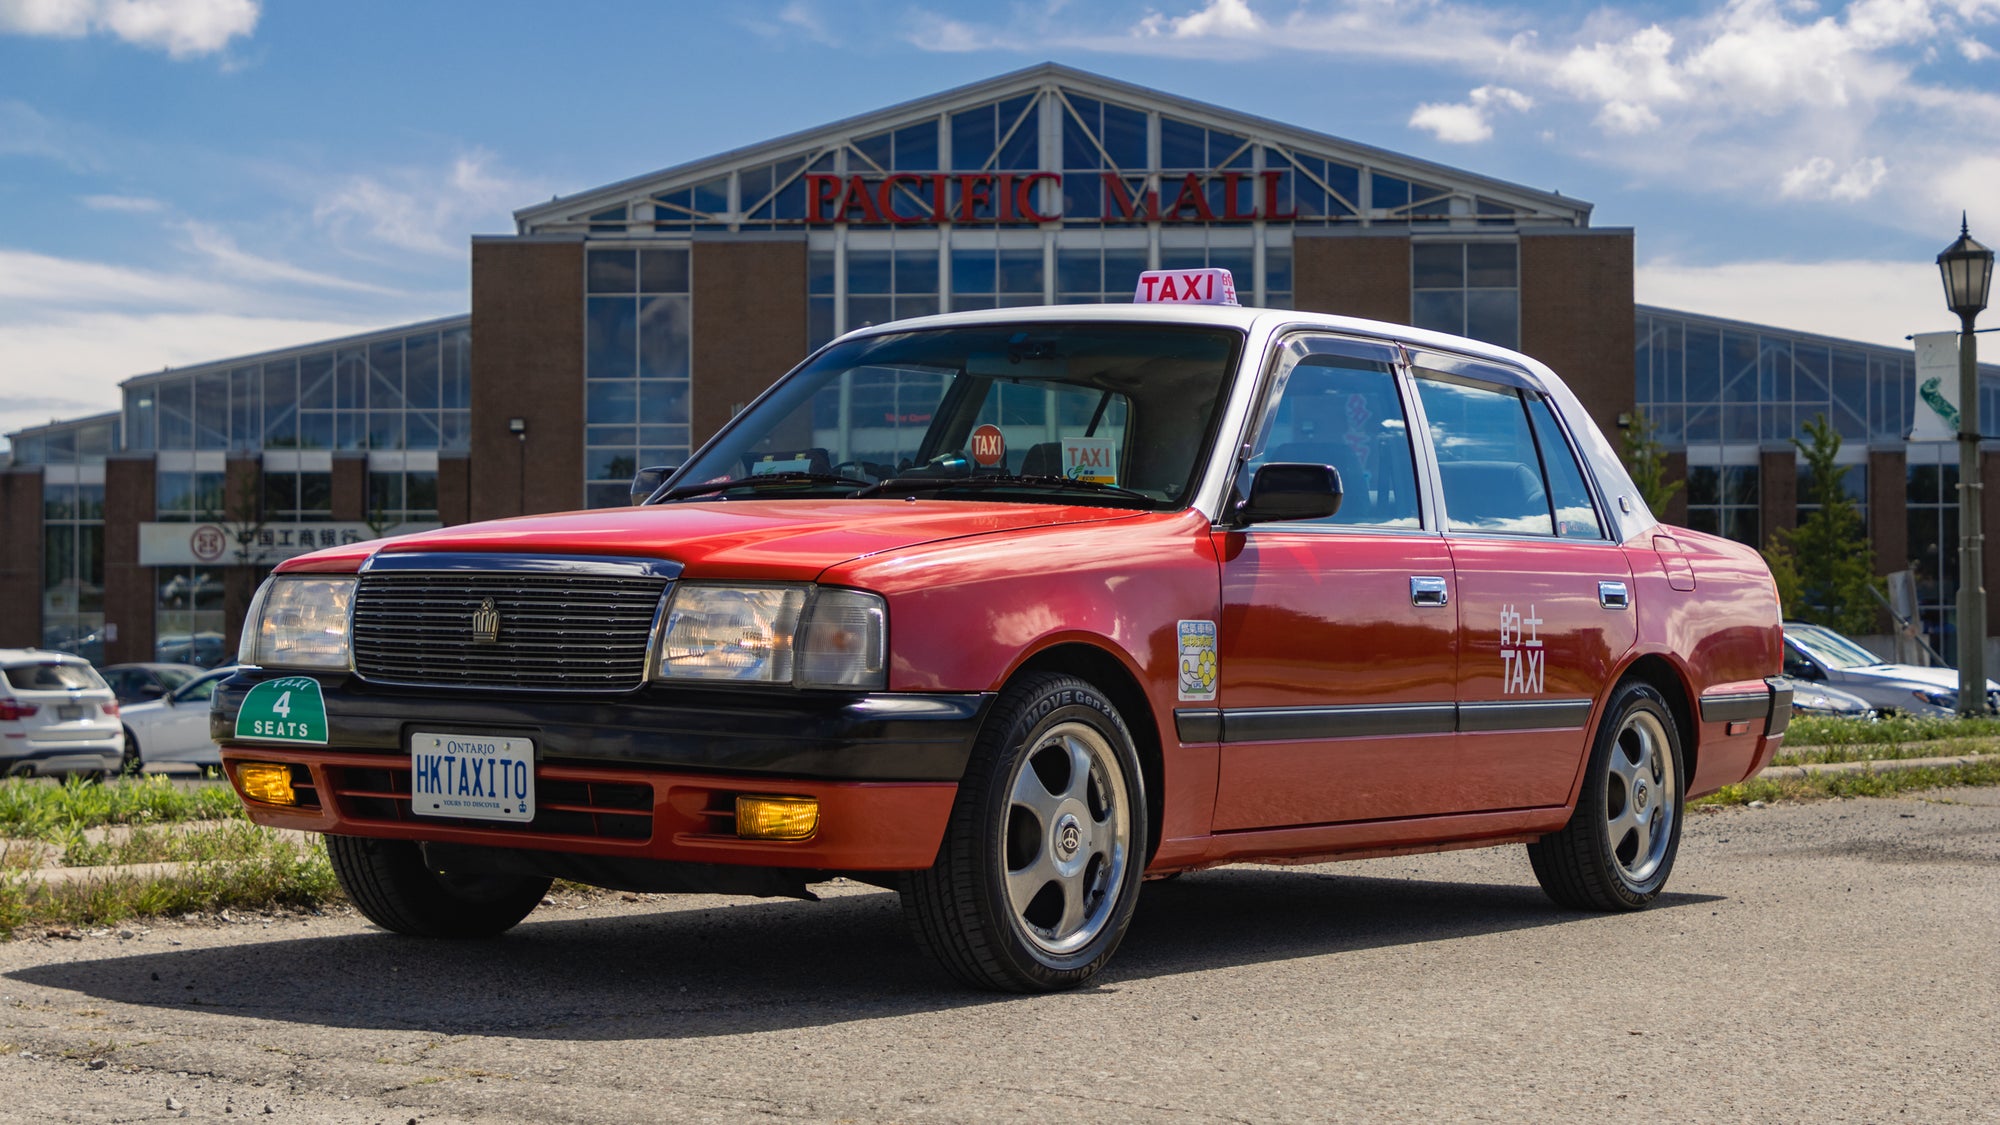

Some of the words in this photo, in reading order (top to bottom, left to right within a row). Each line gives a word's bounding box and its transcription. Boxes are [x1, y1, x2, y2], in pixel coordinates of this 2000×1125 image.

[804, 171, 1062, 224] PACIFIC
[1101, 172, 1298, 223] MALL
[1141, 274, 1214, 302] TAXI
[1221, 273, 1236, 301] 的士
[974, 435, 1001, 456] TAXI
[1067, 446, 1110, 467] TAXI
[1500, 604, 1543, 647] 的士
[273, 679, 312, 691] TAXI
[1500, 650, 1544, 694] TAXI
[272, 691, 291, 718] 4
[1075, 690, 1101, 709] Gen
[1102, 704, 1112, 717] 2
[254, 720, 308, 737] SEATS
[417, 754, 527, 799] HKTAXITO
[443, 799, 461, 807] YOURS
